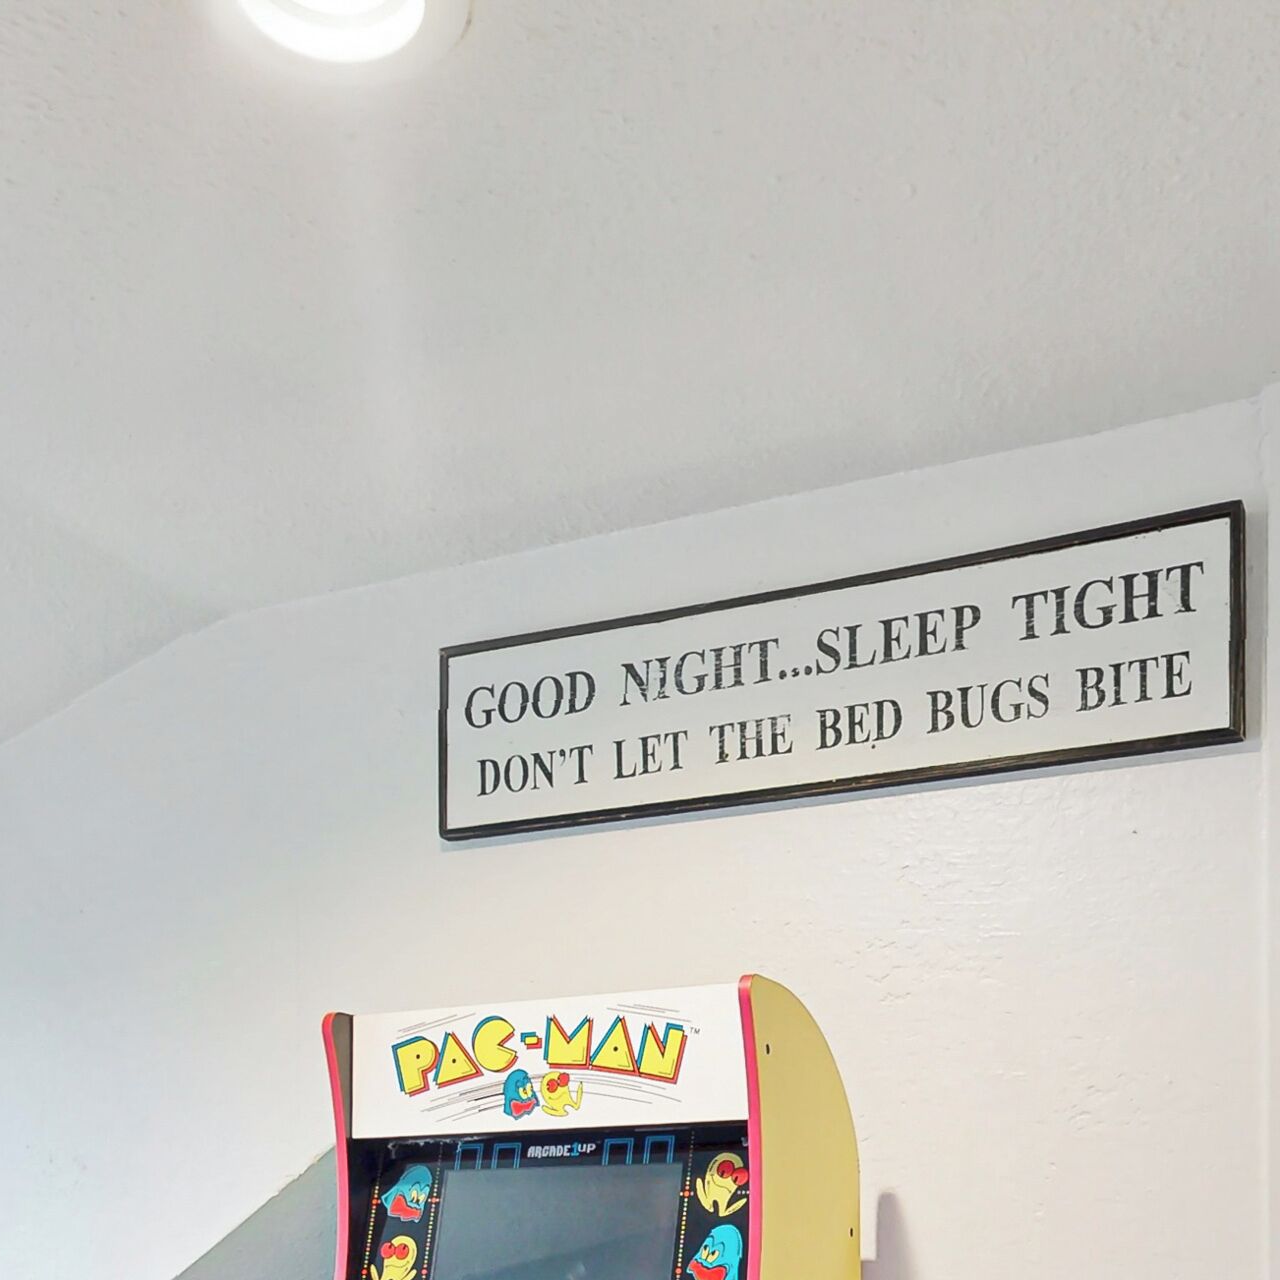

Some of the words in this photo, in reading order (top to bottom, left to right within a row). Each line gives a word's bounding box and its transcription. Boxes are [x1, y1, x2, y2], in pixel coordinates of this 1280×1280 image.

[464, 671, 596, 729] GOOD
[1011, 561, 1205, 641] TIGHT
[477, 744, 593, 797] DON'T
[613, 730, 688, 780] LET
[709, 714, 792, 765] THE
[815, 699, 903, 751] BED
[926, 673, 1049, 734] BUGS
[1075, 650, 1192, 712] BITE
[392, 1014, 688, 1096] PAC-MAN
